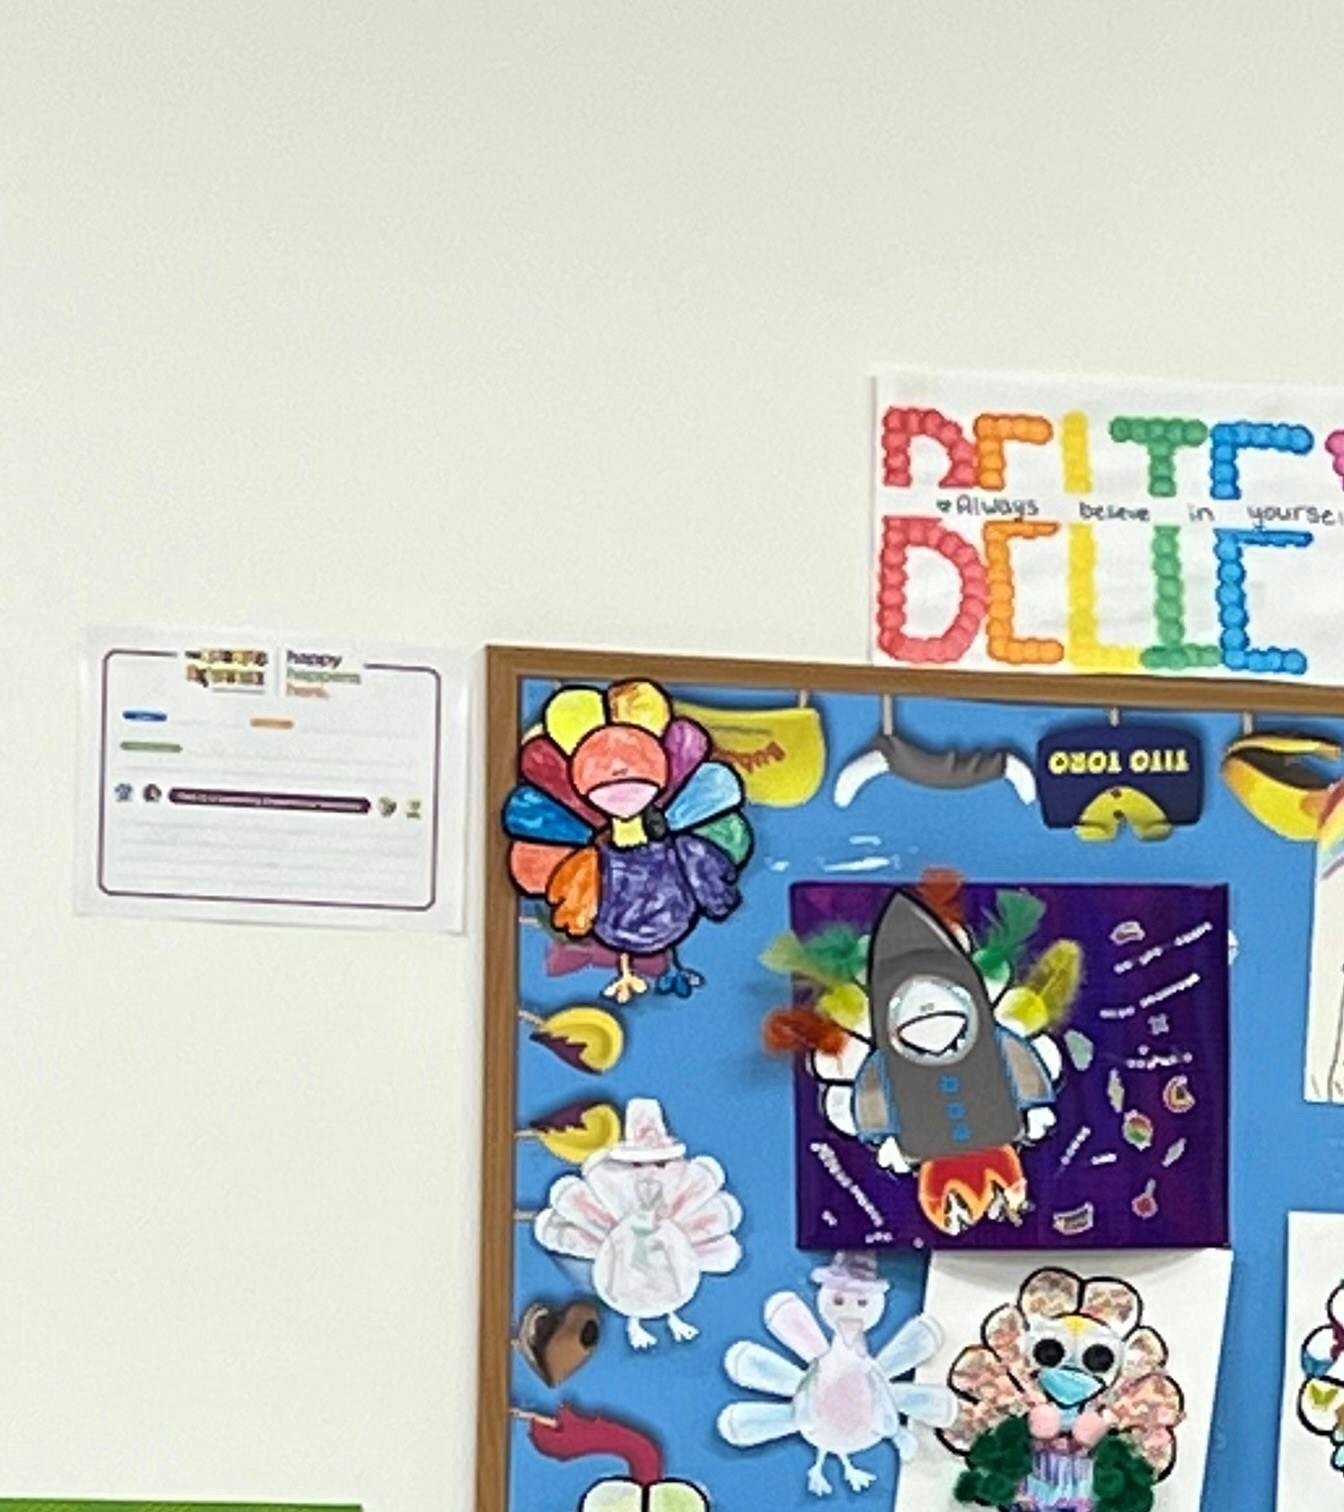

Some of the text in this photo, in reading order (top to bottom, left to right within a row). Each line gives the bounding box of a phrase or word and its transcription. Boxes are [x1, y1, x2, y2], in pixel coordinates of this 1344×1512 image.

[1189, 503, 1215, 523] in
[1048, 748, 1190, 777] TITO TORO
